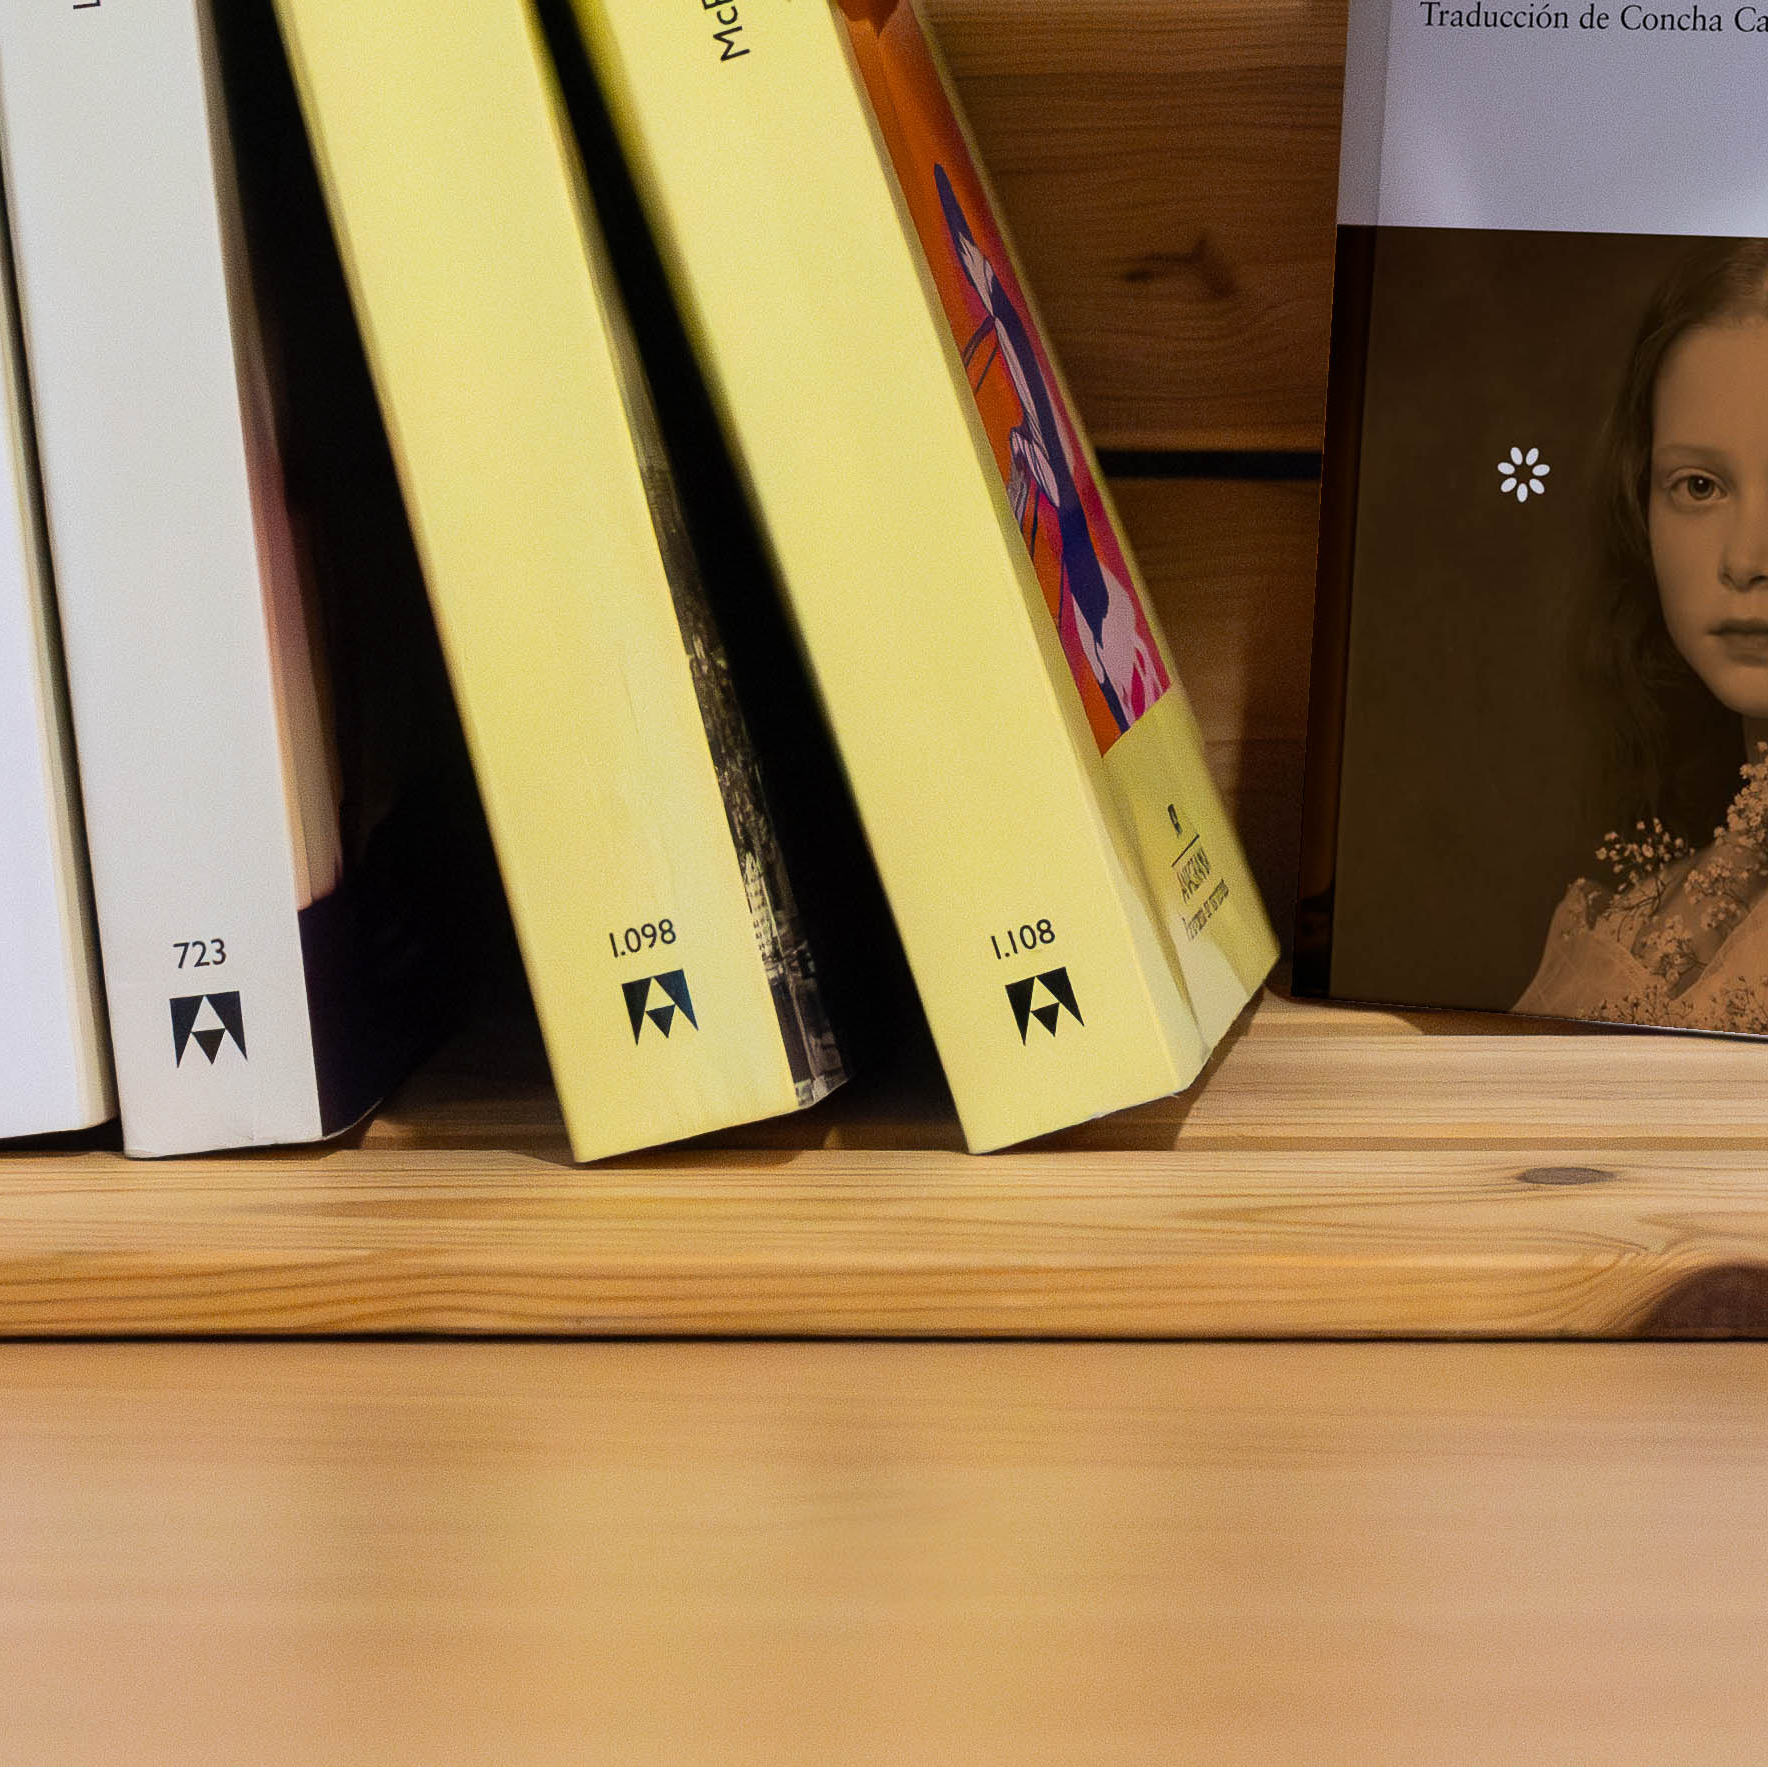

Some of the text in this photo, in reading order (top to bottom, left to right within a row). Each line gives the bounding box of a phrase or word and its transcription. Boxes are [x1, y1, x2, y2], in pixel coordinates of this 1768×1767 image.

[1419, 0, 1569, 29] Traducción
[1579, 3, 1610, 30] de
[1620, 4, 1723, 32] Concha
[172, 938, 227, 969] 723
[608, 918, 677, 959] 1.098
[990, 918, 1056, 960] 1.108
